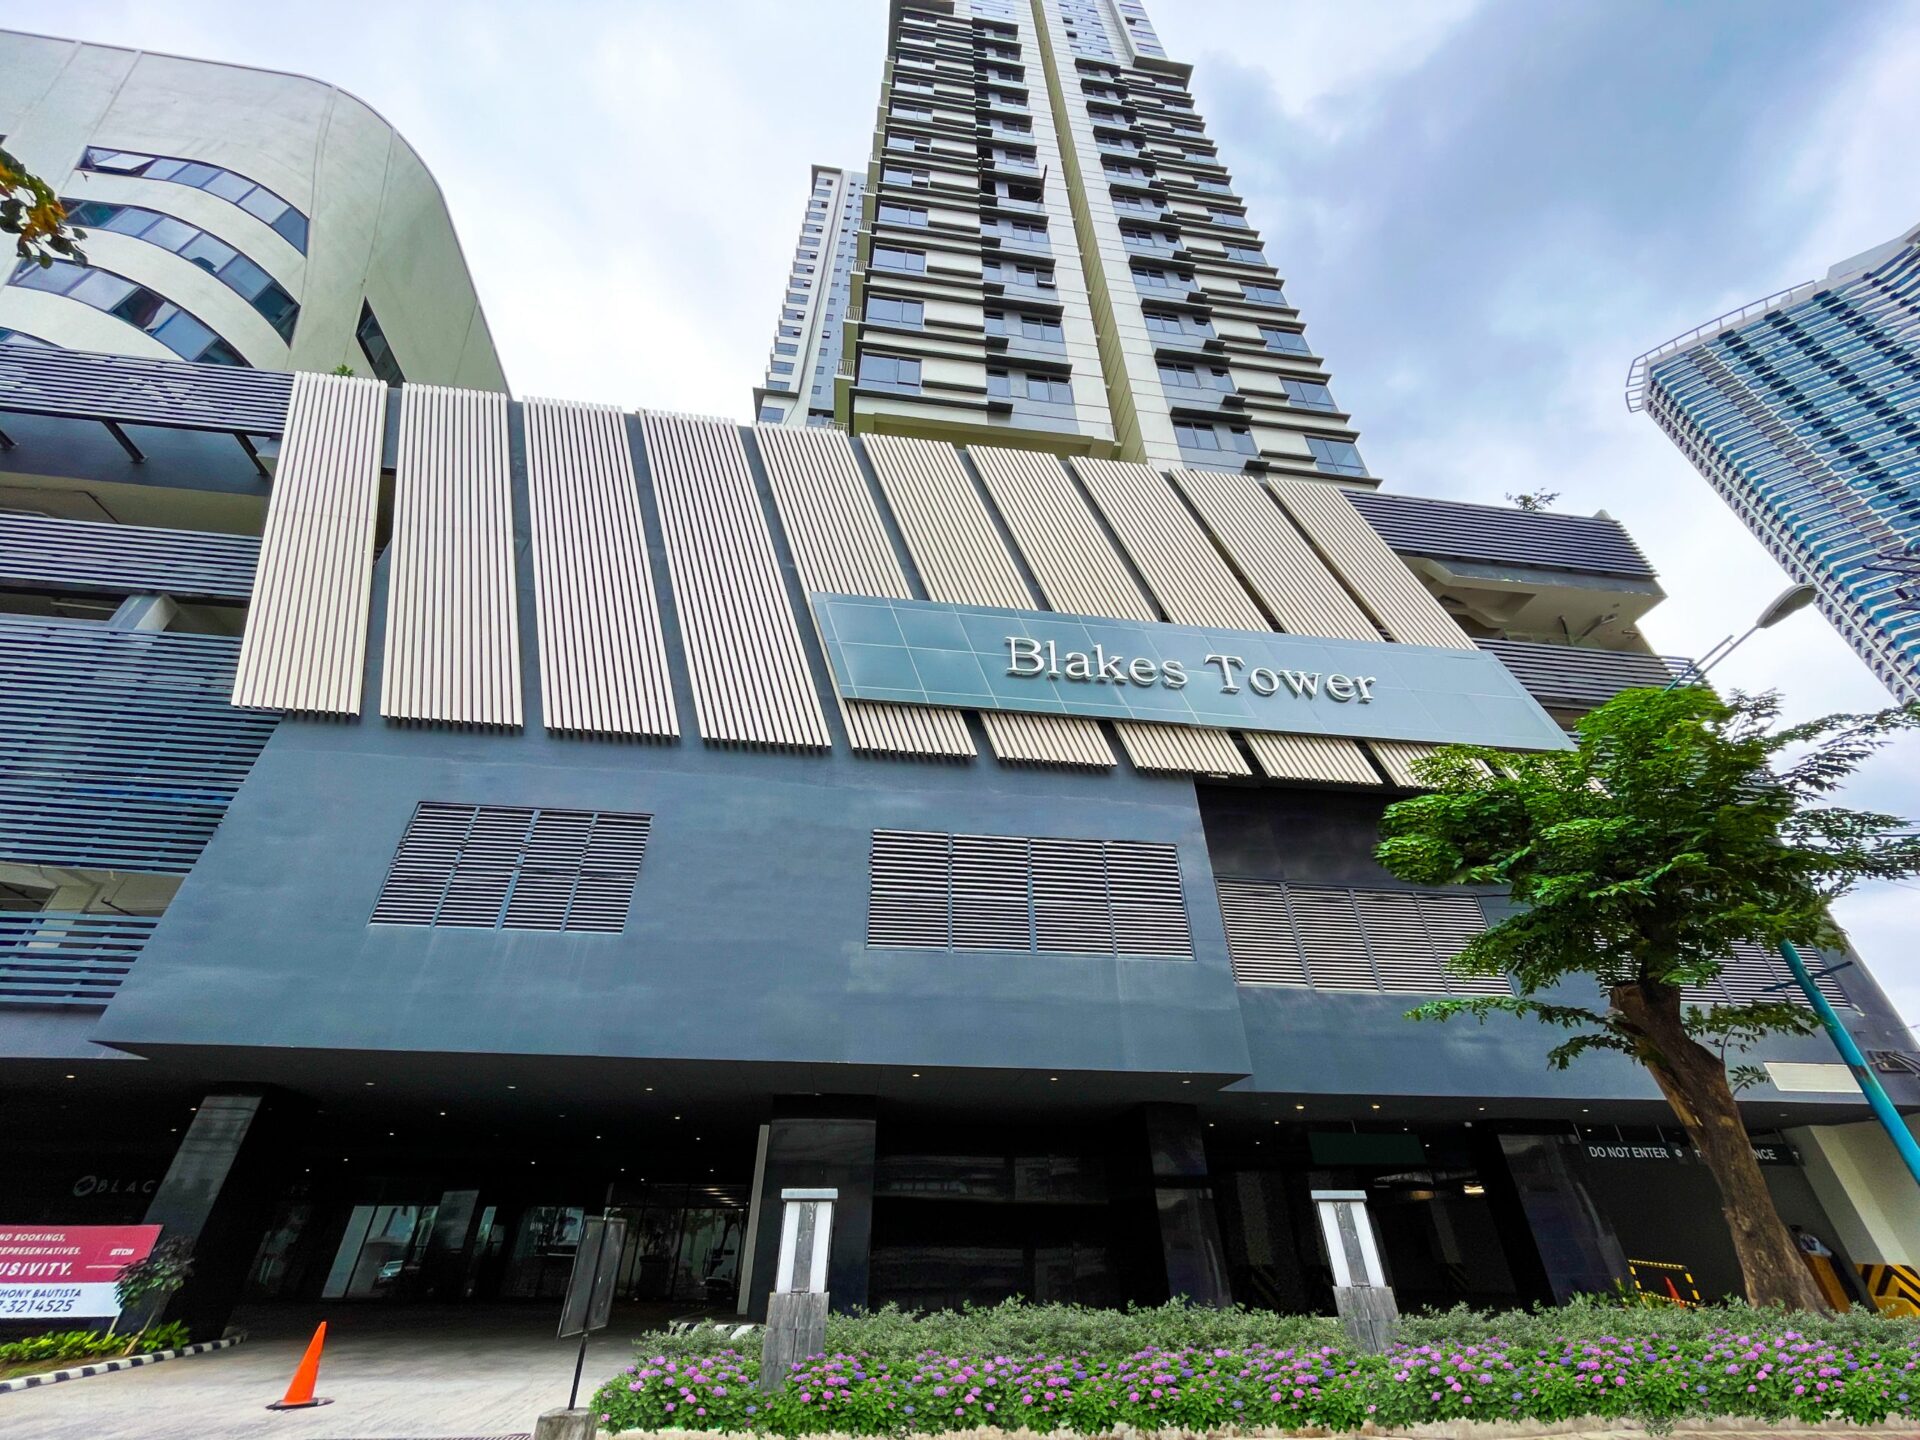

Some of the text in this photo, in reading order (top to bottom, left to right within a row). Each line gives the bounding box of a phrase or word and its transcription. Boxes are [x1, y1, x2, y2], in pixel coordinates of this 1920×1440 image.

[1005, 636, 1376, 704] Blakes Tower
[1588, 1146, 1670, 1159] DO NOT ENTER
[96, 1179, 156, 1193] BLAC
[14, 1233, 66, 1242] BOOKINGS,
[0, 1289, 81, 1298] HONY BAUTISTA
